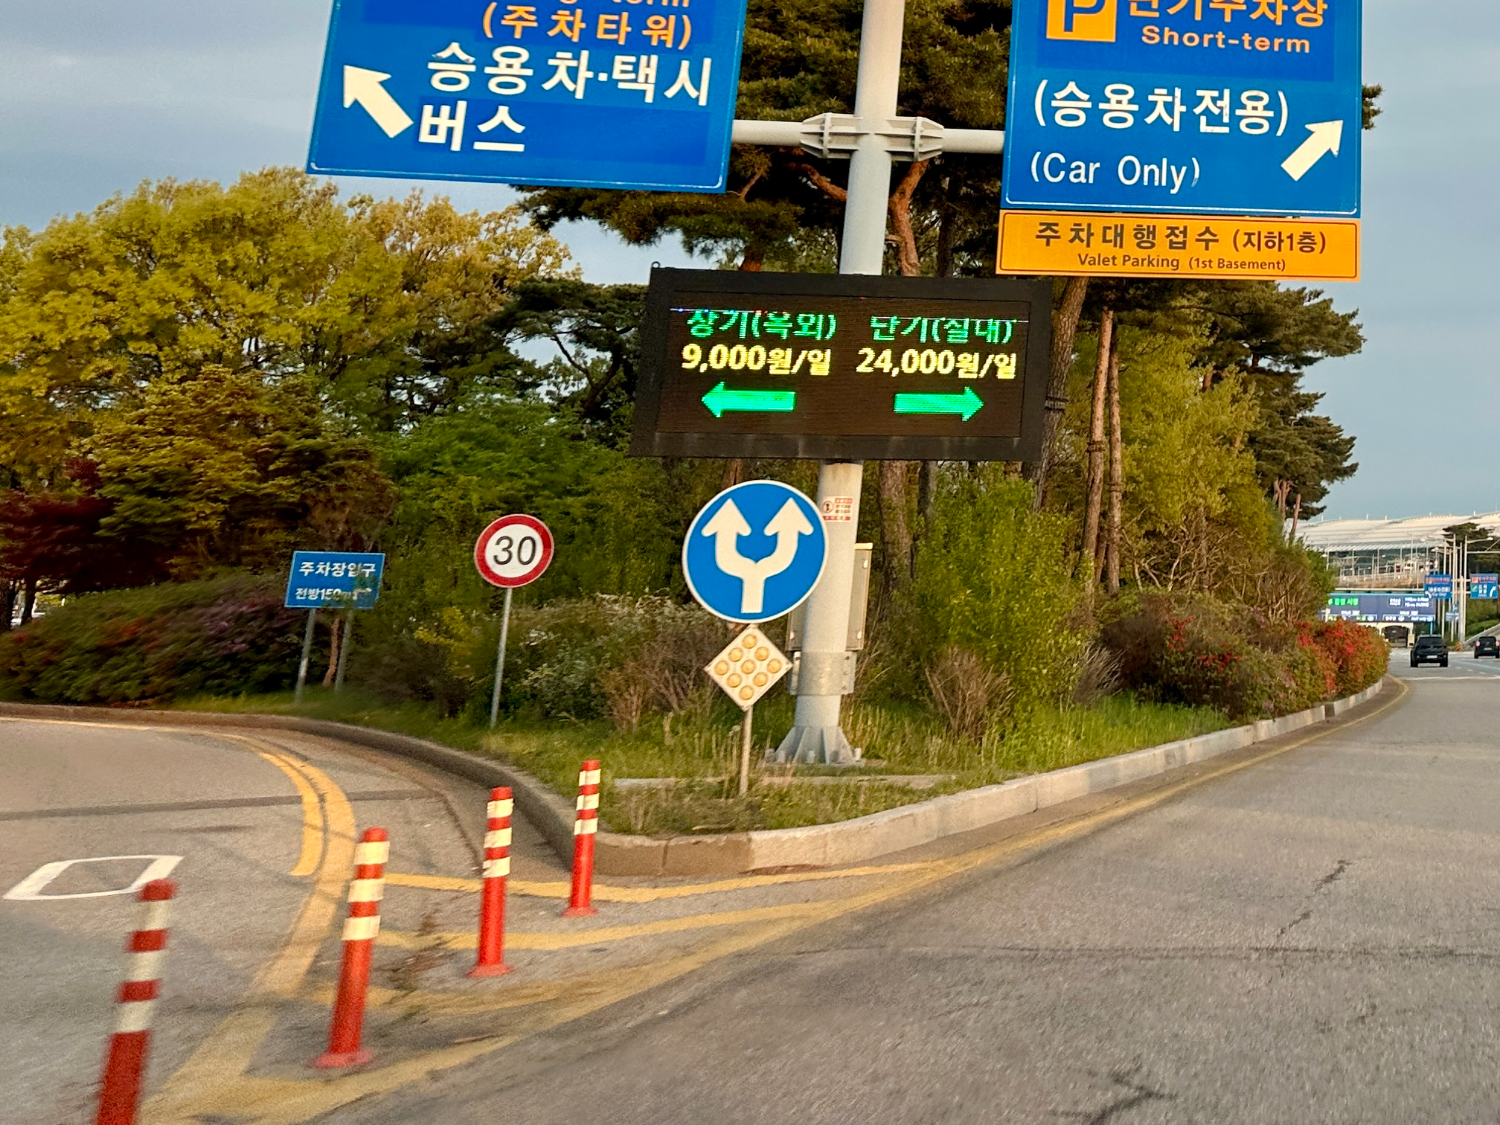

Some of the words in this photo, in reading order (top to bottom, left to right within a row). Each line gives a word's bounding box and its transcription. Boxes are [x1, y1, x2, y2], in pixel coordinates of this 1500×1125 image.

[1141, 25, 1311, 54] Short-term
[1034, 79, 1288, 136] (승용차전용)
[418, 100, 526, 153] 버스
[1030, 151, 1100, 185] (Car
[1117, 154, 1201, 195] Only)
[1232, 229, 1327, 254] (지하1층)
[1077, 253, 1117, 267] Valet
[1121, 254, 1180, 271] Parking
[1188, 256, 1215, 271] (1st
[1217, 256, 1286, 272] Basement)
[681, 343, 832, 376] 9,000원/일
[856, 347, 1017, 380] 24,000원/일
[492, 535, 538, 566] 30
[299, 561, 376, 578] 주차장입구
